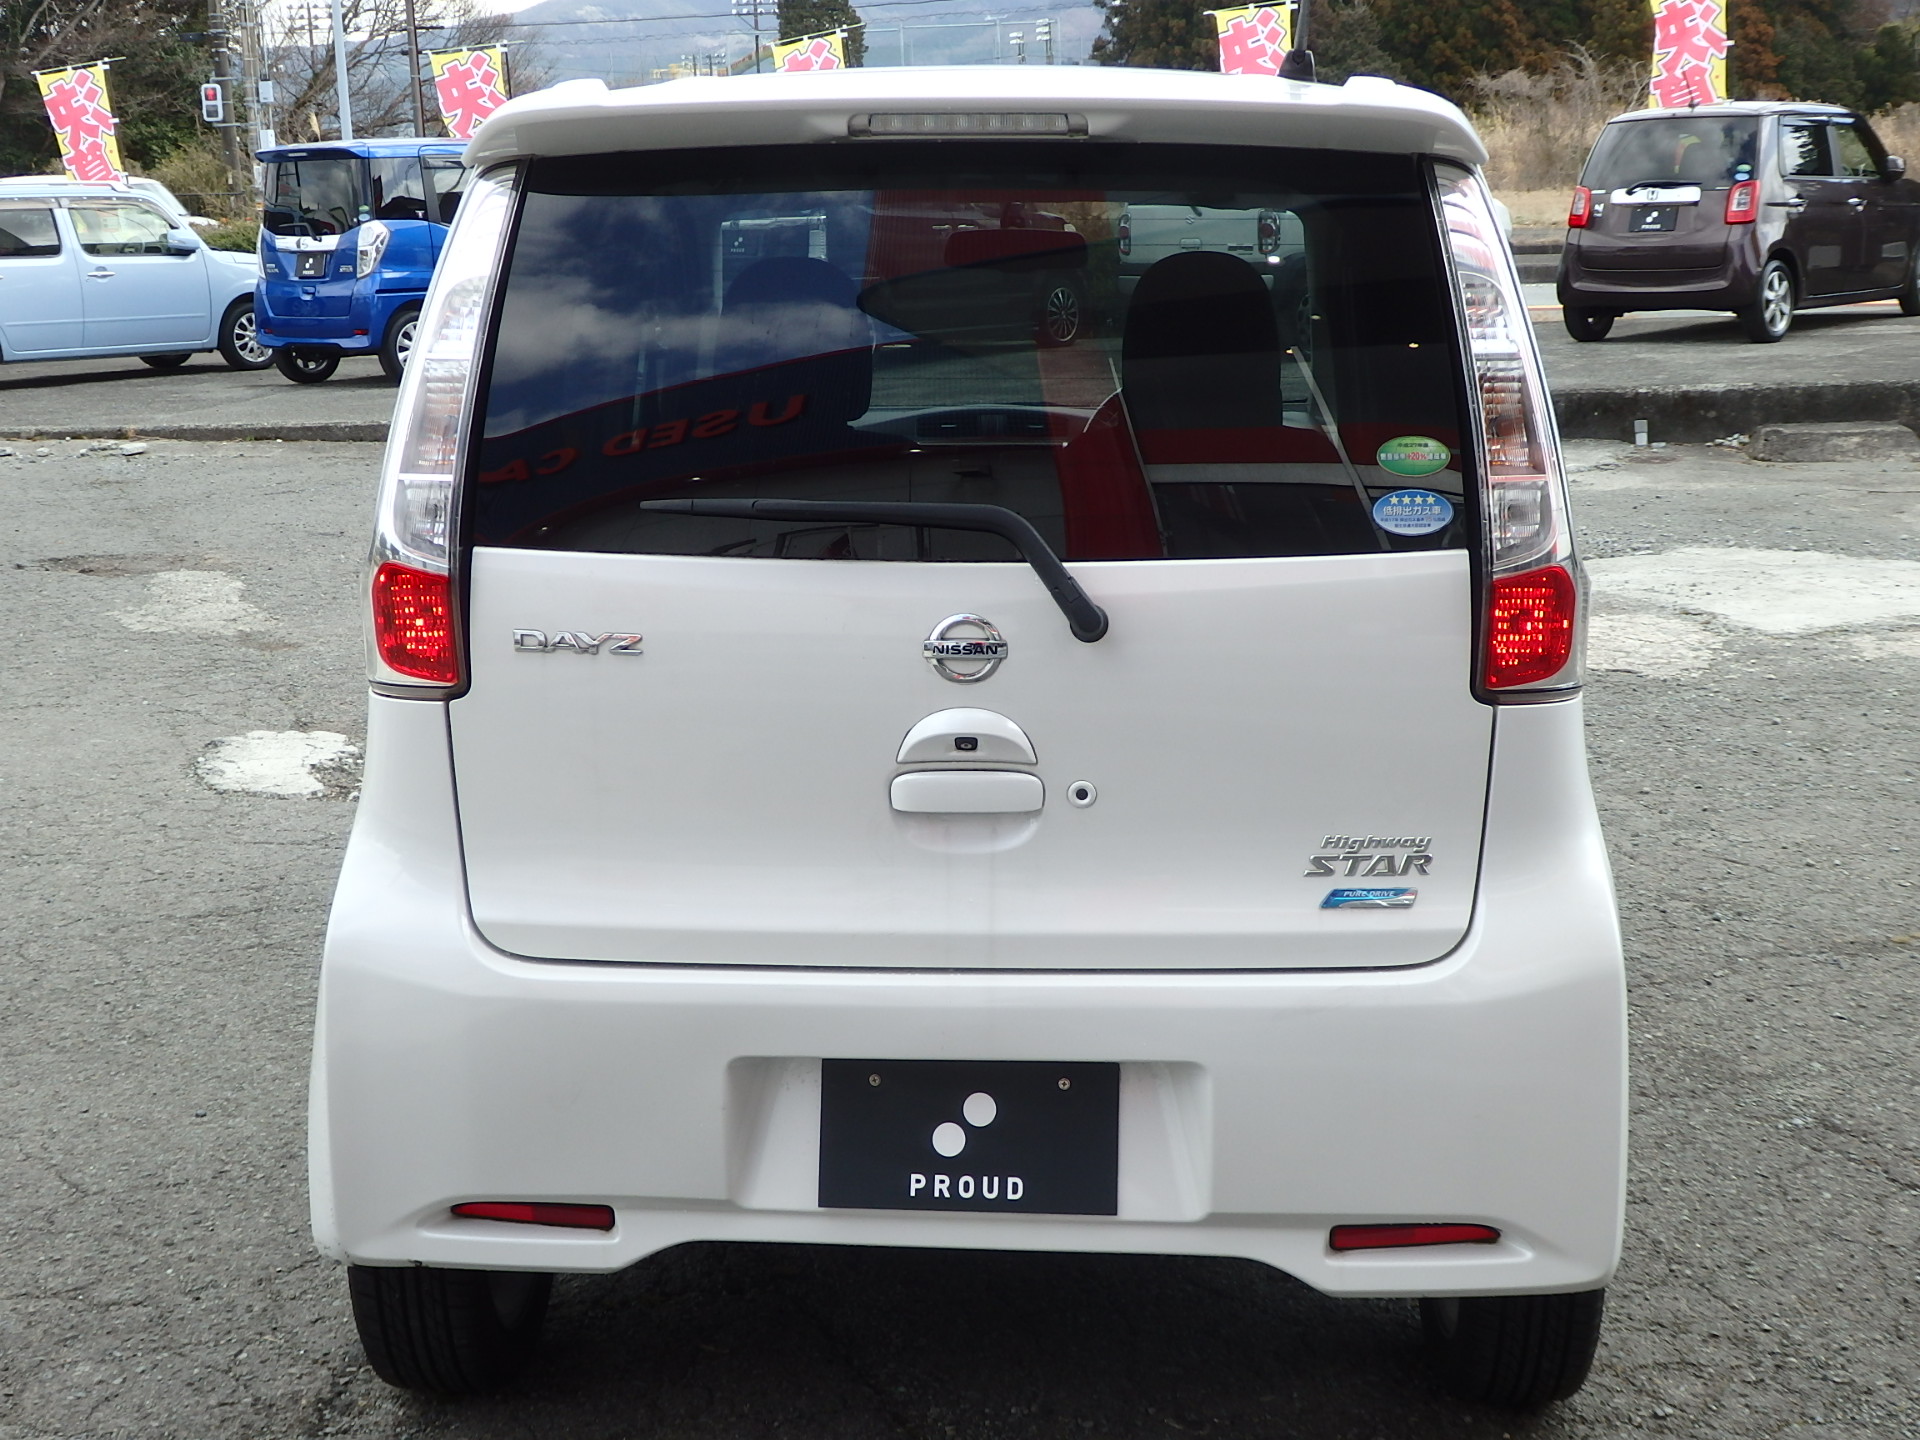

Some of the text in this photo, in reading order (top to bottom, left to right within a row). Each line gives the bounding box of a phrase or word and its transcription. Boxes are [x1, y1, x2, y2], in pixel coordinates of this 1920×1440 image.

[1383, 505, 1442, 516] 低排出ガス車
[512, 628, 643, 656] DAYZ
[932, 644, 998, 656] NISSAN
[1320, 834, 1432, 854] Highway
[1303, 853, 1433, 877] STAR
[909, 1173, 1024, 1200] PROUD
